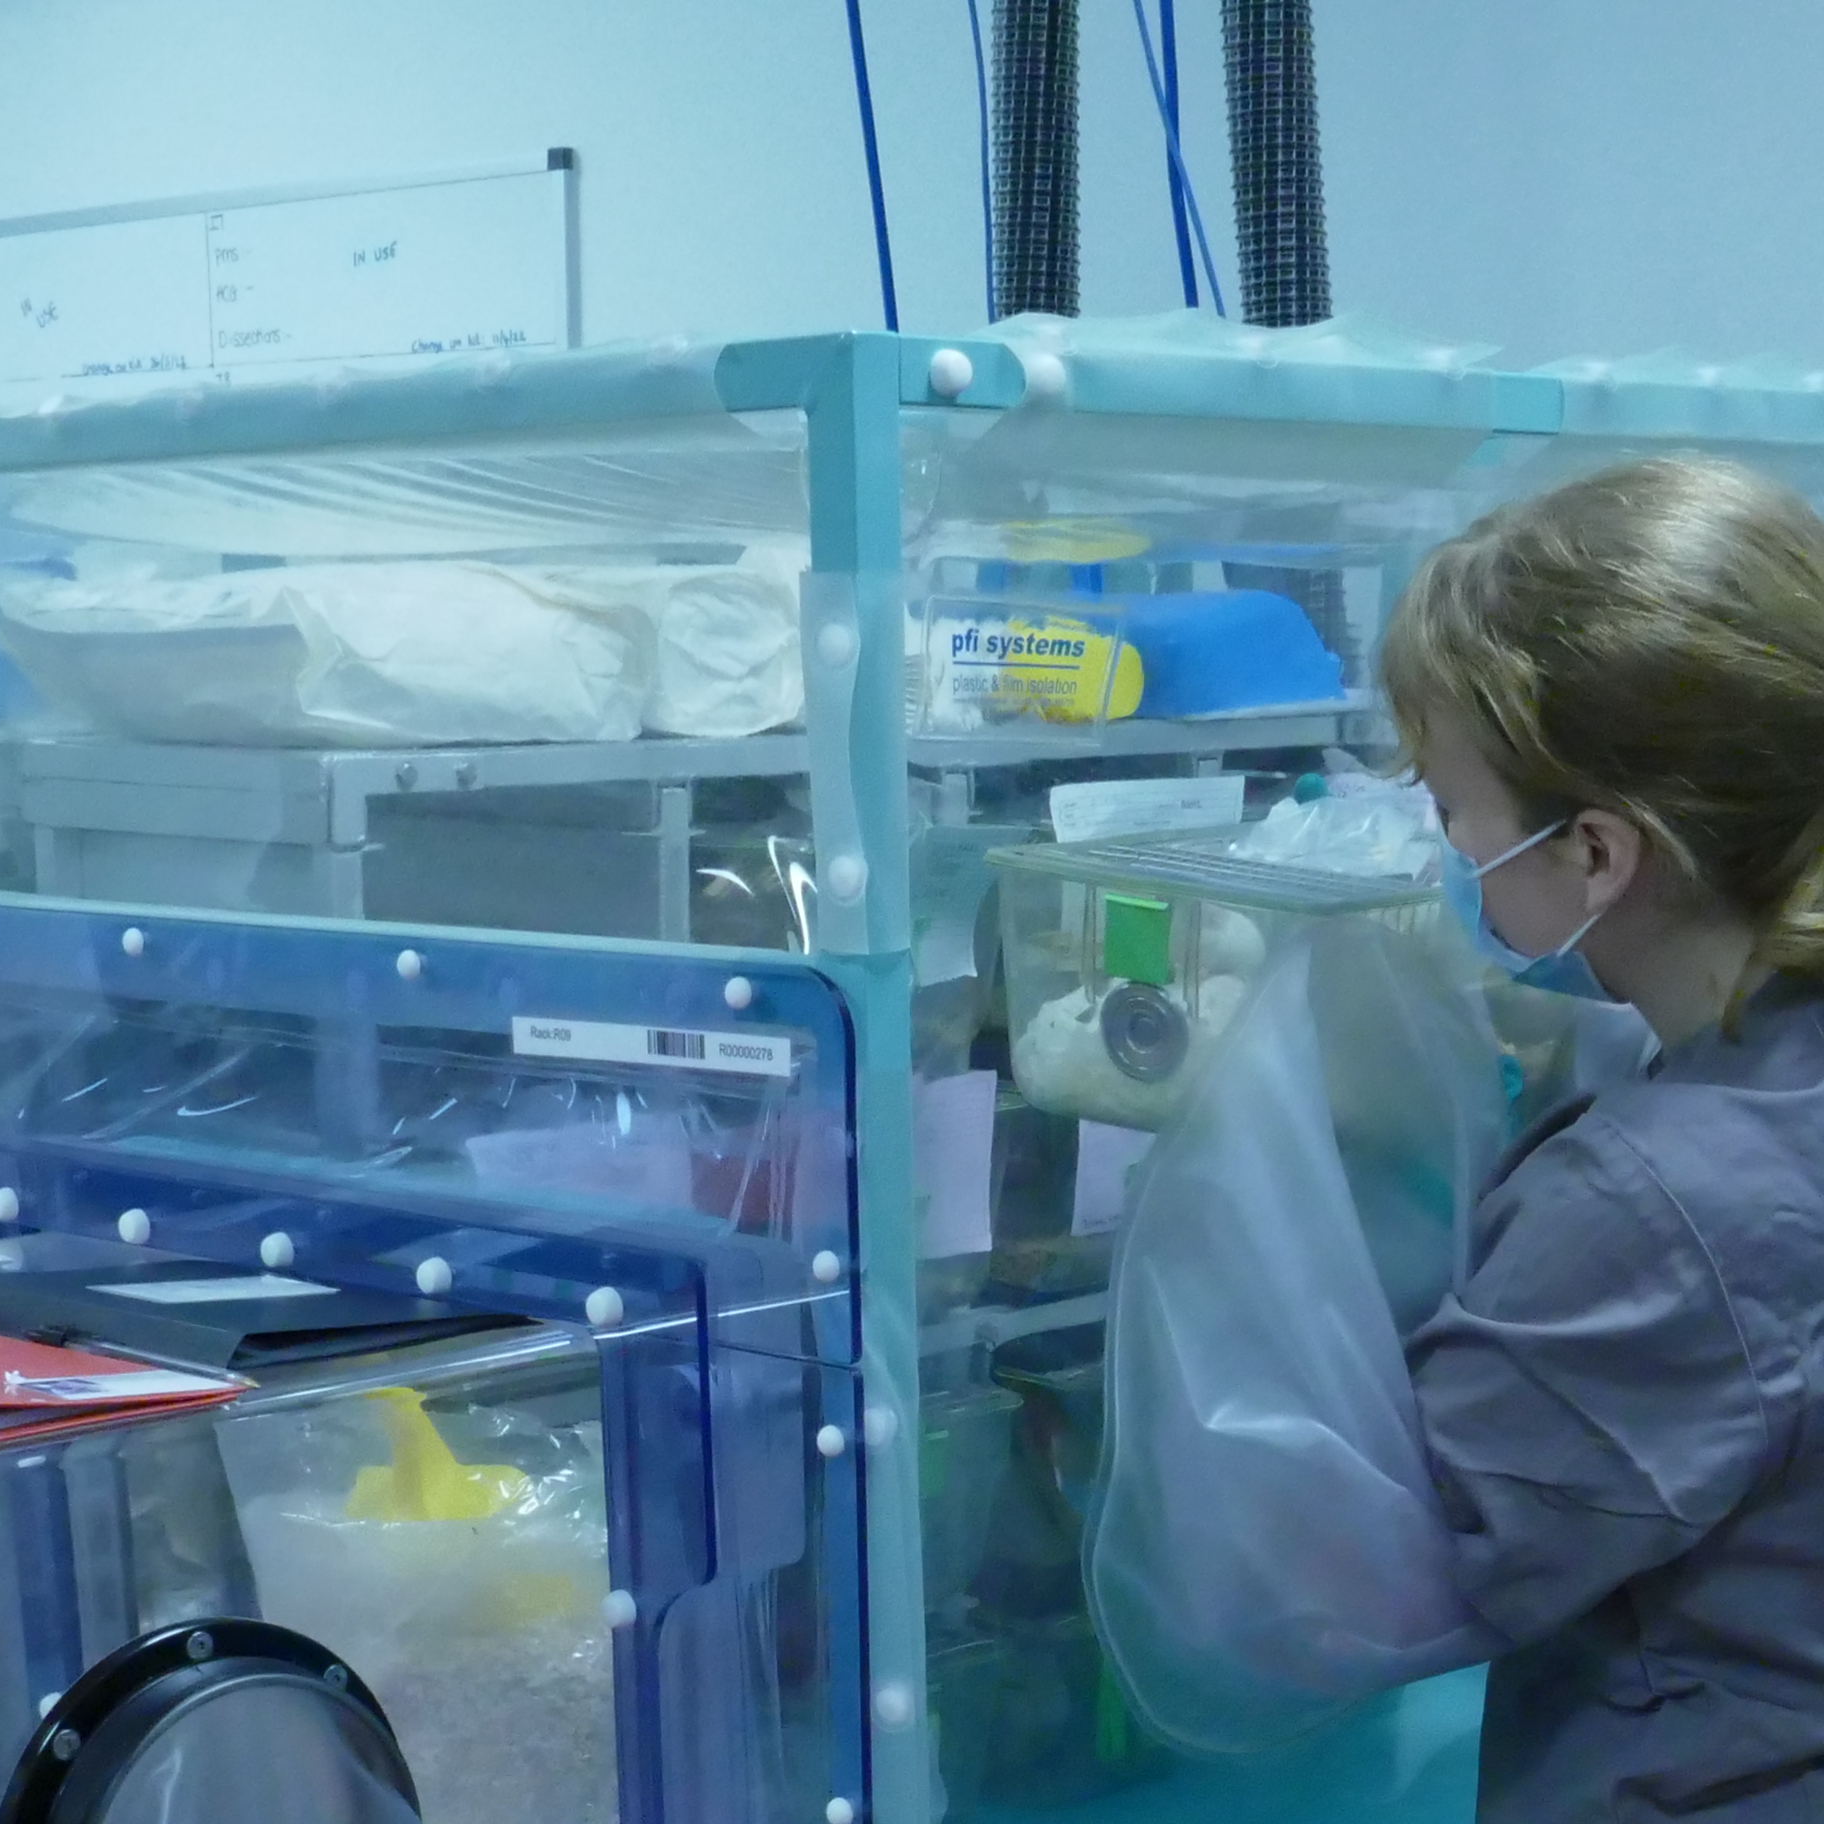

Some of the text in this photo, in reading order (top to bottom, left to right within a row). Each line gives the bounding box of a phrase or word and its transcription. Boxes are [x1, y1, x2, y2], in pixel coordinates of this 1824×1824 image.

[374, 241, 398, 262] USE
[951, 628, 1086, 660] pfi systems
[952, 674, 1078, 695] plastic & film isolation
